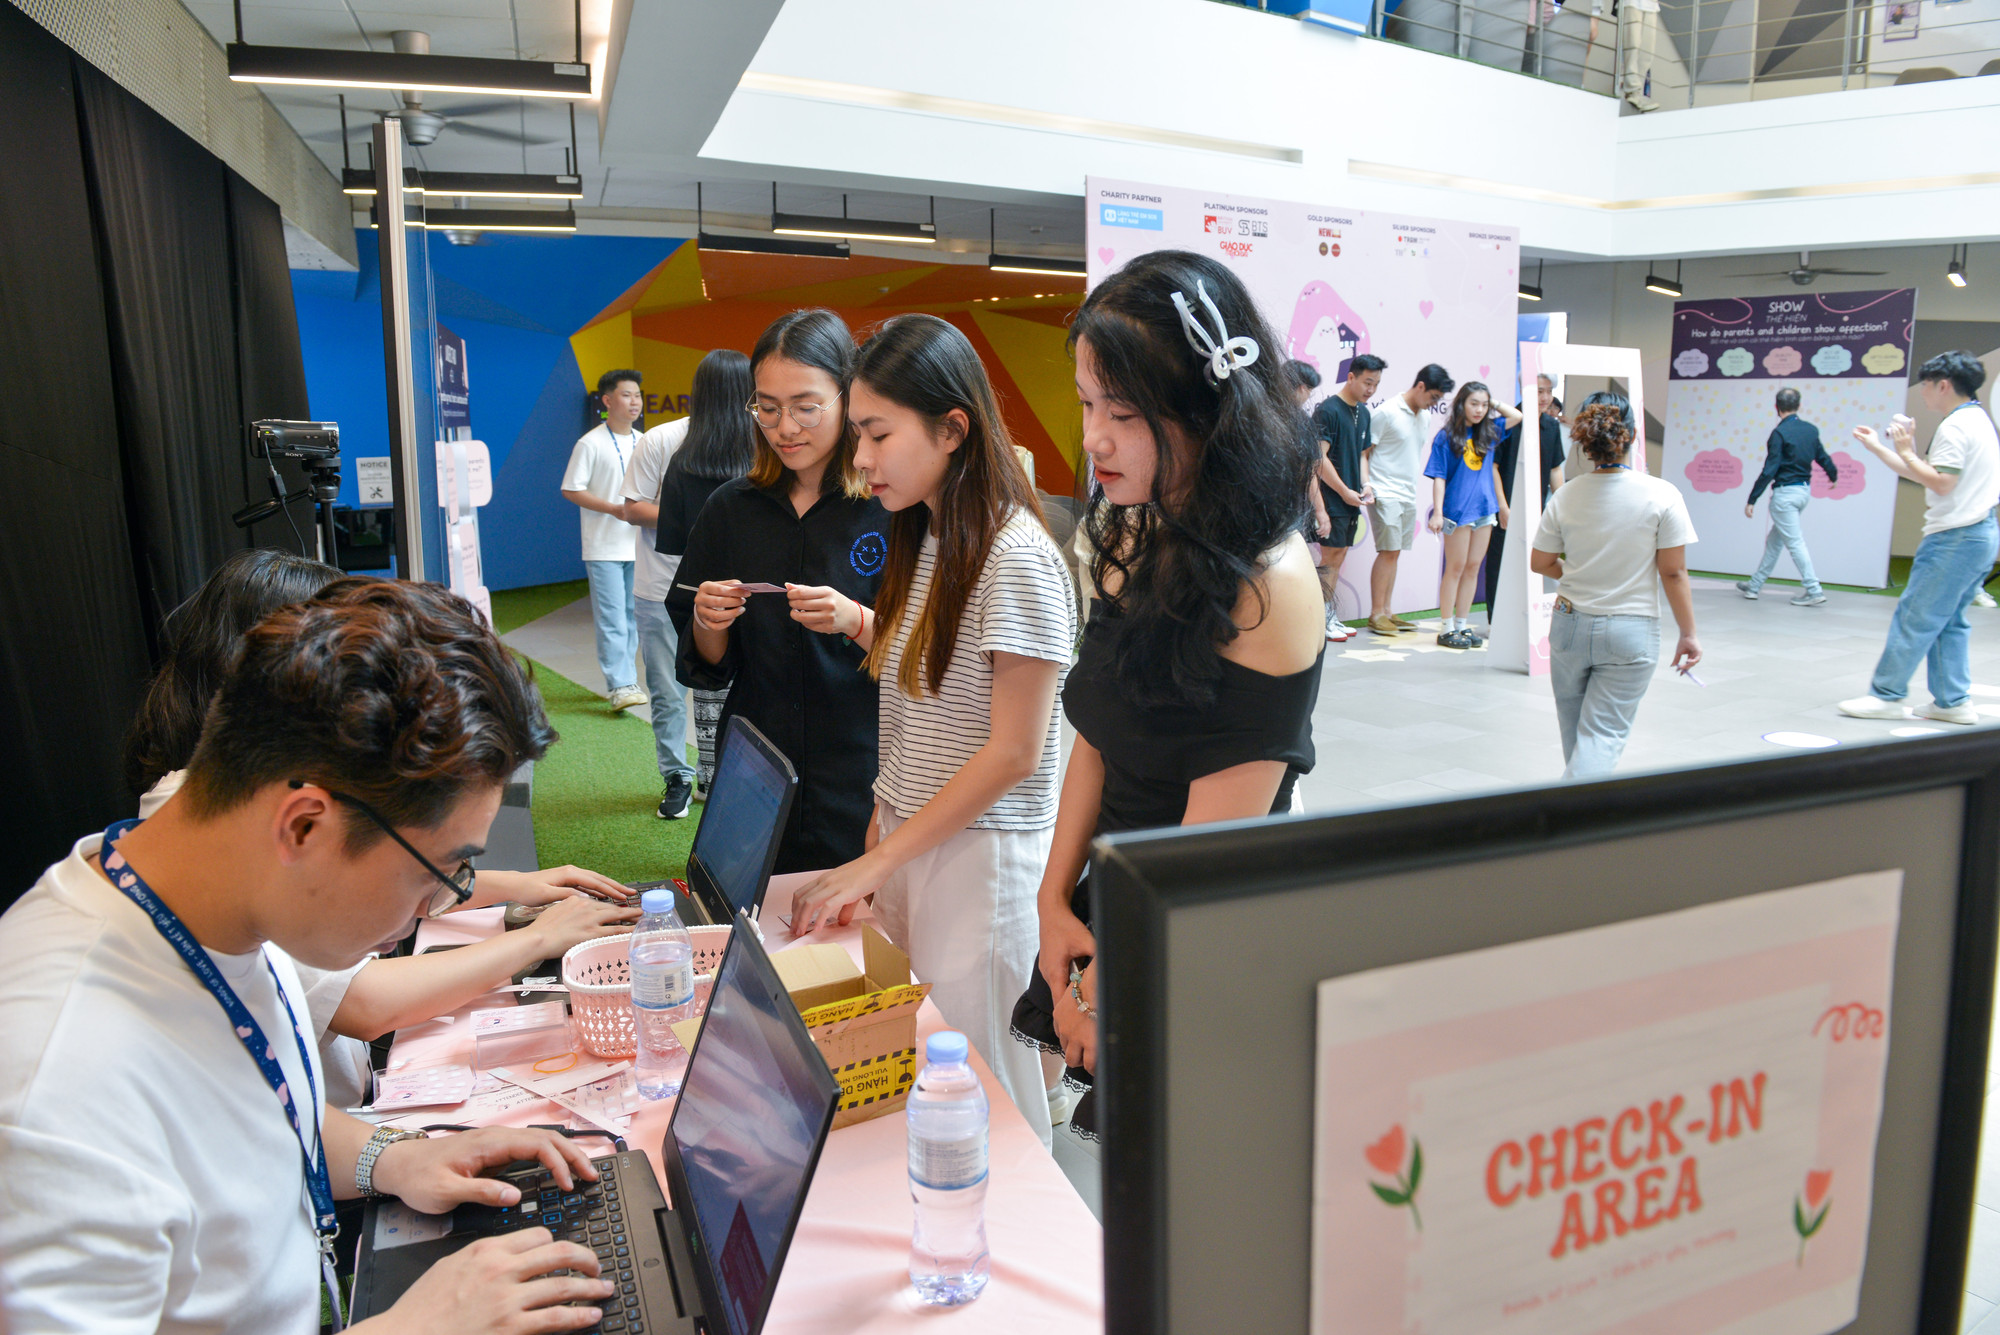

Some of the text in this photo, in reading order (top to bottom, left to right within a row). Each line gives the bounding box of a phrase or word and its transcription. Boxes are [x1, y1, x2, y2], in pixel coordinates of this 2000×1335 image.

[1101, 190, 1162, 203] CHARITY PARTNER
[1204, 202, 1268, 216] PLATINUM SPONSORS
[1307, 214, 1352, 225] GOLD SPONSORS
[1217, 225, 1232, 235] BUV
[1251, 221, 1268, 233] BTS
[1392, 223, 1436, 234] SILVER SPONSORS
[1469, 232, 1512, 242] BRONZE SPONSORS
[1768, 300, 1805, 314] SHOW
[1691, 320, 1888, 339] How do parents and children show affection?
[196, 959, 214, 979] LOVE
[874, 1067, 888, 1076] VUI
[857, 1075, 888, 1093] HÀNG
[1485, 1071, 1768, 1209] CHECK-IN
[1549, 1155, 1703, 1259] AREA
